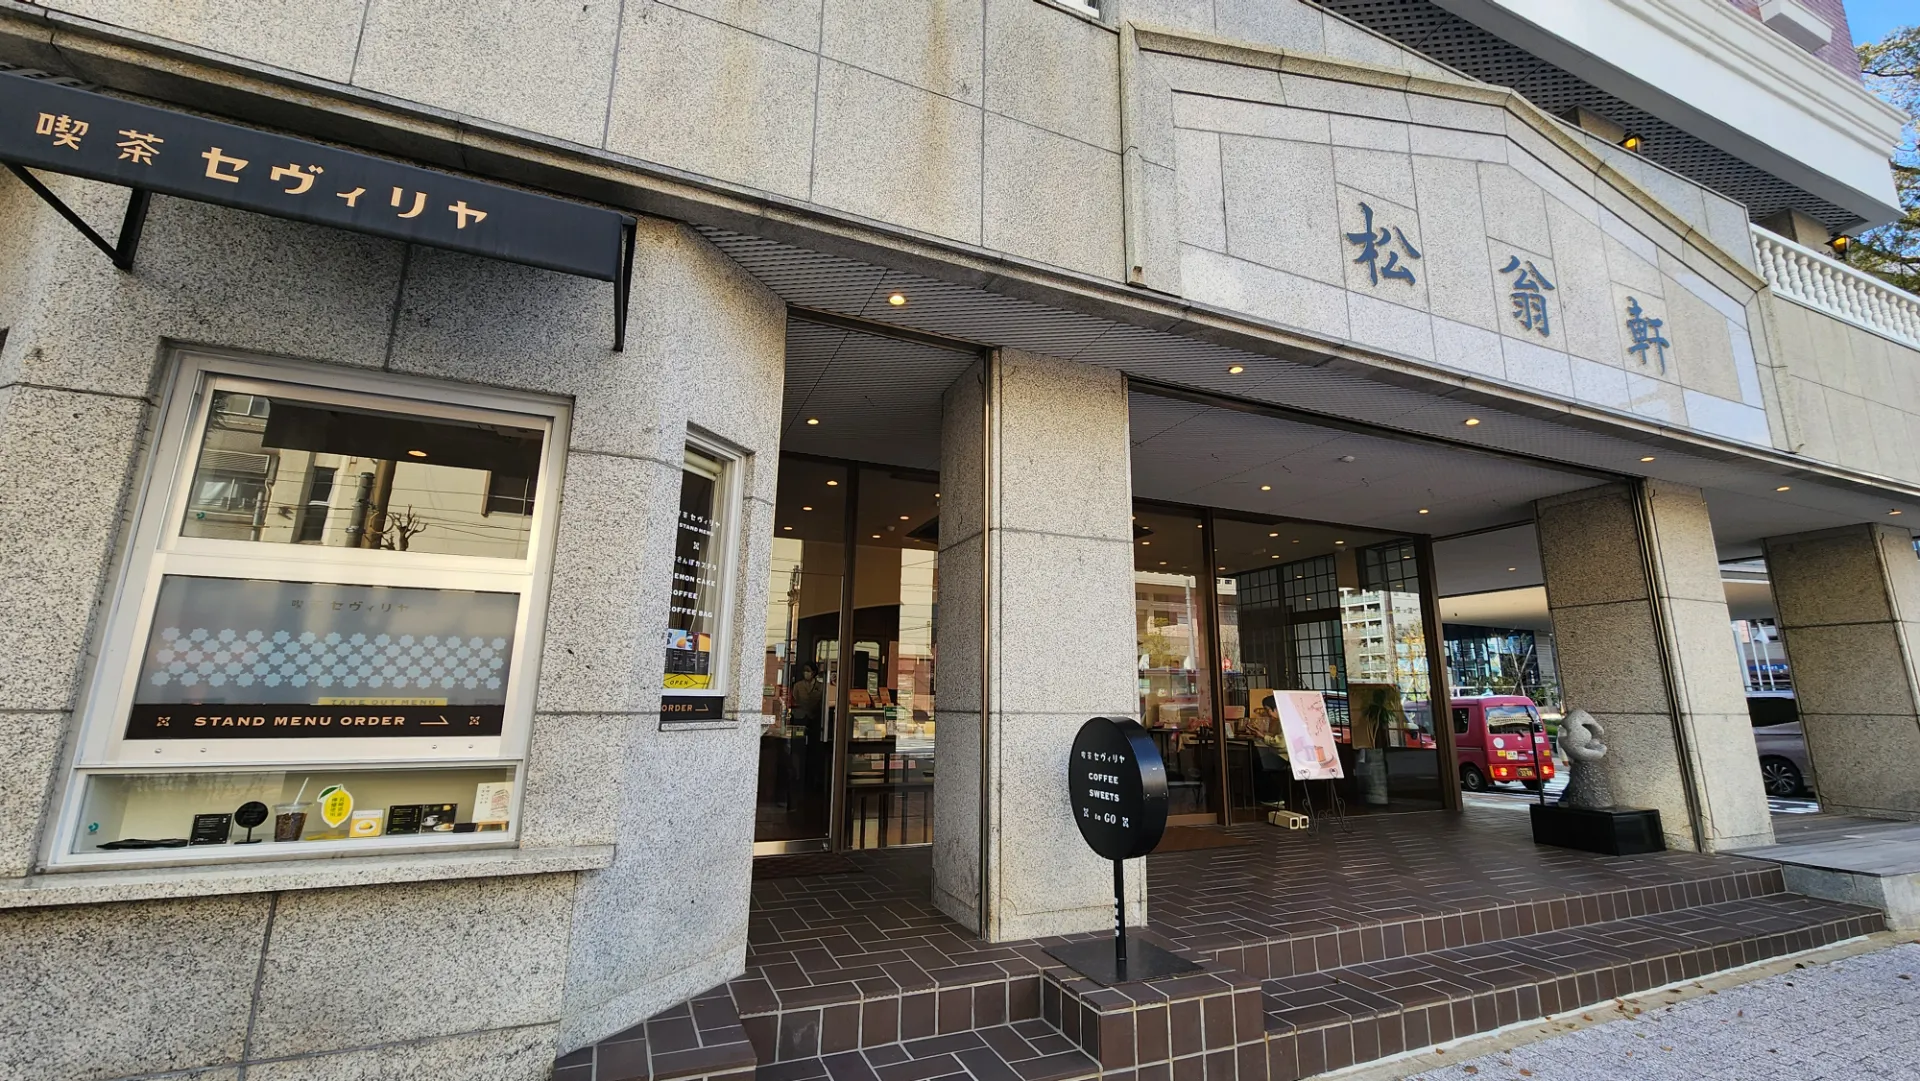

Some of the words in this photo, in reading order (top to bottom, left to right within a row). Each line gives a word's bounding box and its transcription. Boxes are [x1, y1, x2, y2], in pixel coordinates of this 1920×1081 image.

[35, 112, 488, 229] 喫茶セヴィリヤ
[1346, 201, 1670, 376] 松翁軒
[679, 522, 698, 532] STAND
[674, 572, 695, 582] EMON
[696, 577, 716, 587] CAKE
[670, 589, 698, 599] OFFEE
[670, 606, 697, 615] OFFEE
[698, 610, 713, 618] BAG
[661, 704, 693, 712] ORDER
[194, 716, 266, 726] STAND
[274, 716, 332, 726] MENU
[339, 716, 406, 726] ORDER
[1088, 772, 1119, 785] COFFEE
[1089, 789, 1120, 802] SWEETS
[1104, 812, 1117, 824] GO
